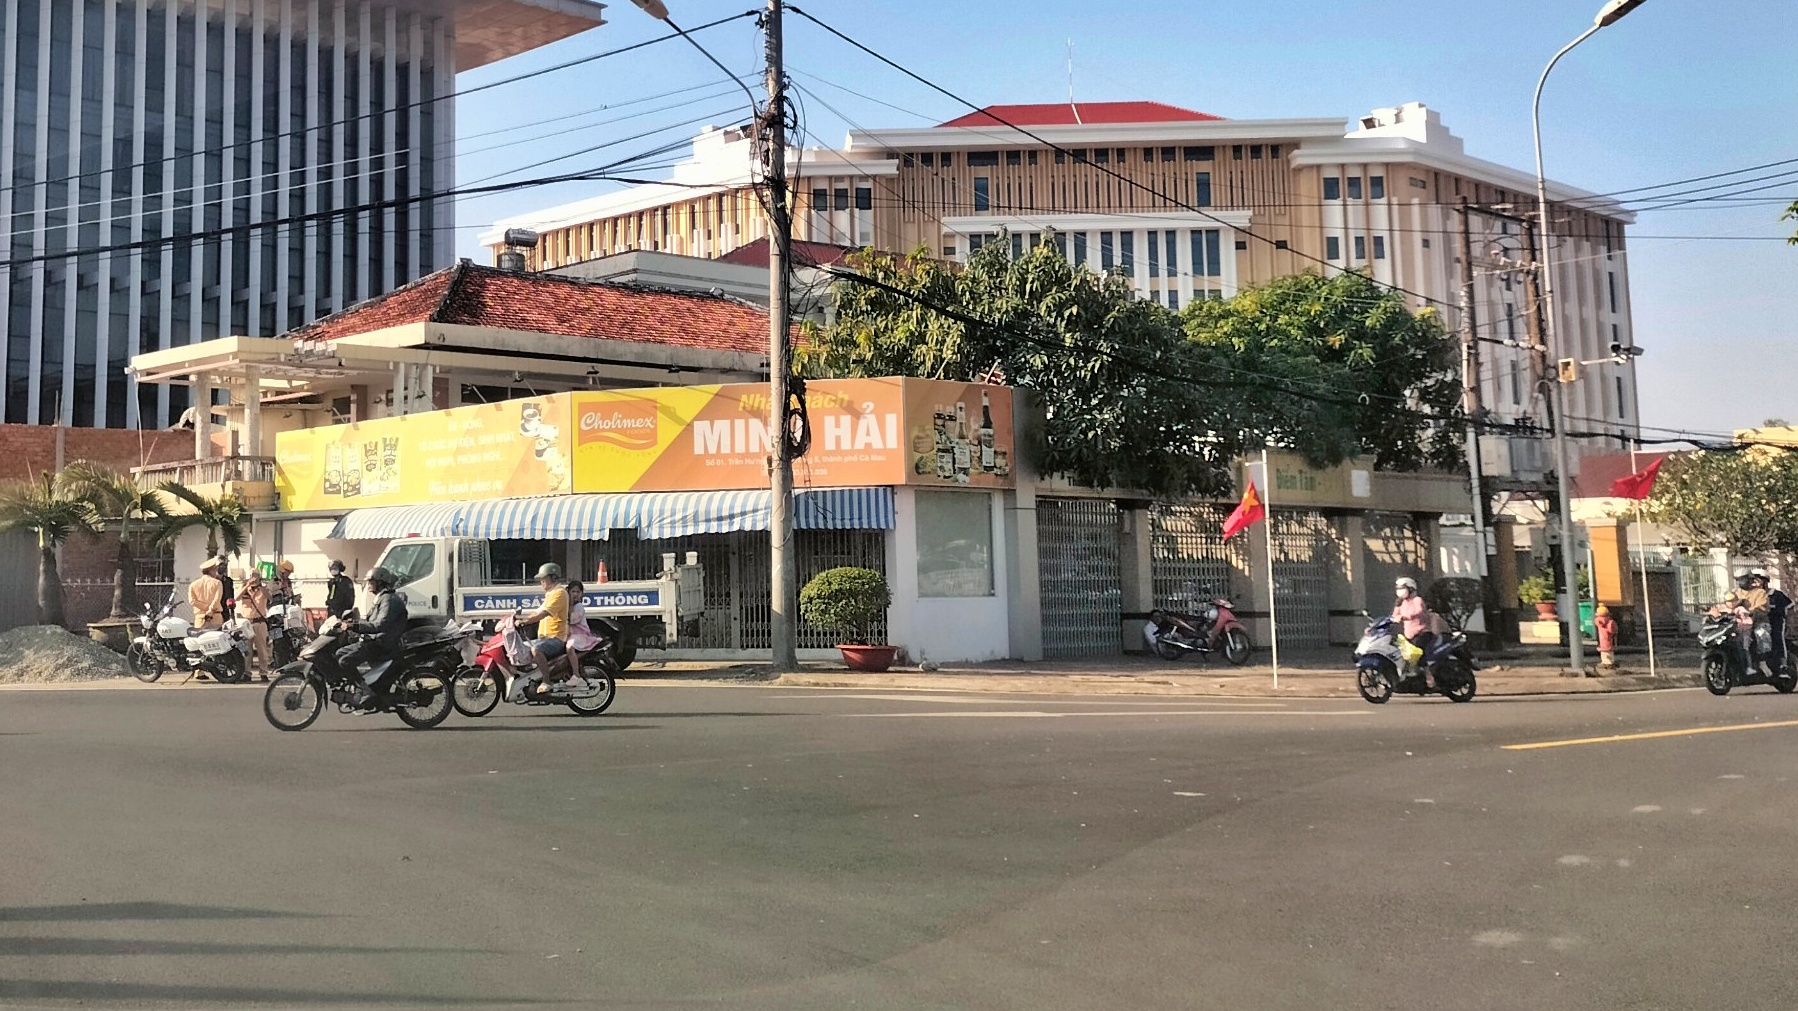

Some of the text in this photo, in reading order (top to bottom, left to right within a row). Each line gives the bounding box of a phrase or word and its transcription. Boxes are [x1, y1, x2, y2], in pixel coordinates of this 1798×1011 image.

[580, 412, 655, 430] Cholimex
[824, 401, 898, 450] HẢI
[844, 454, 858, 463] phố
[474, 596, 517, 609] CẢNH
[594, 590, 648, 606] THÔNG
